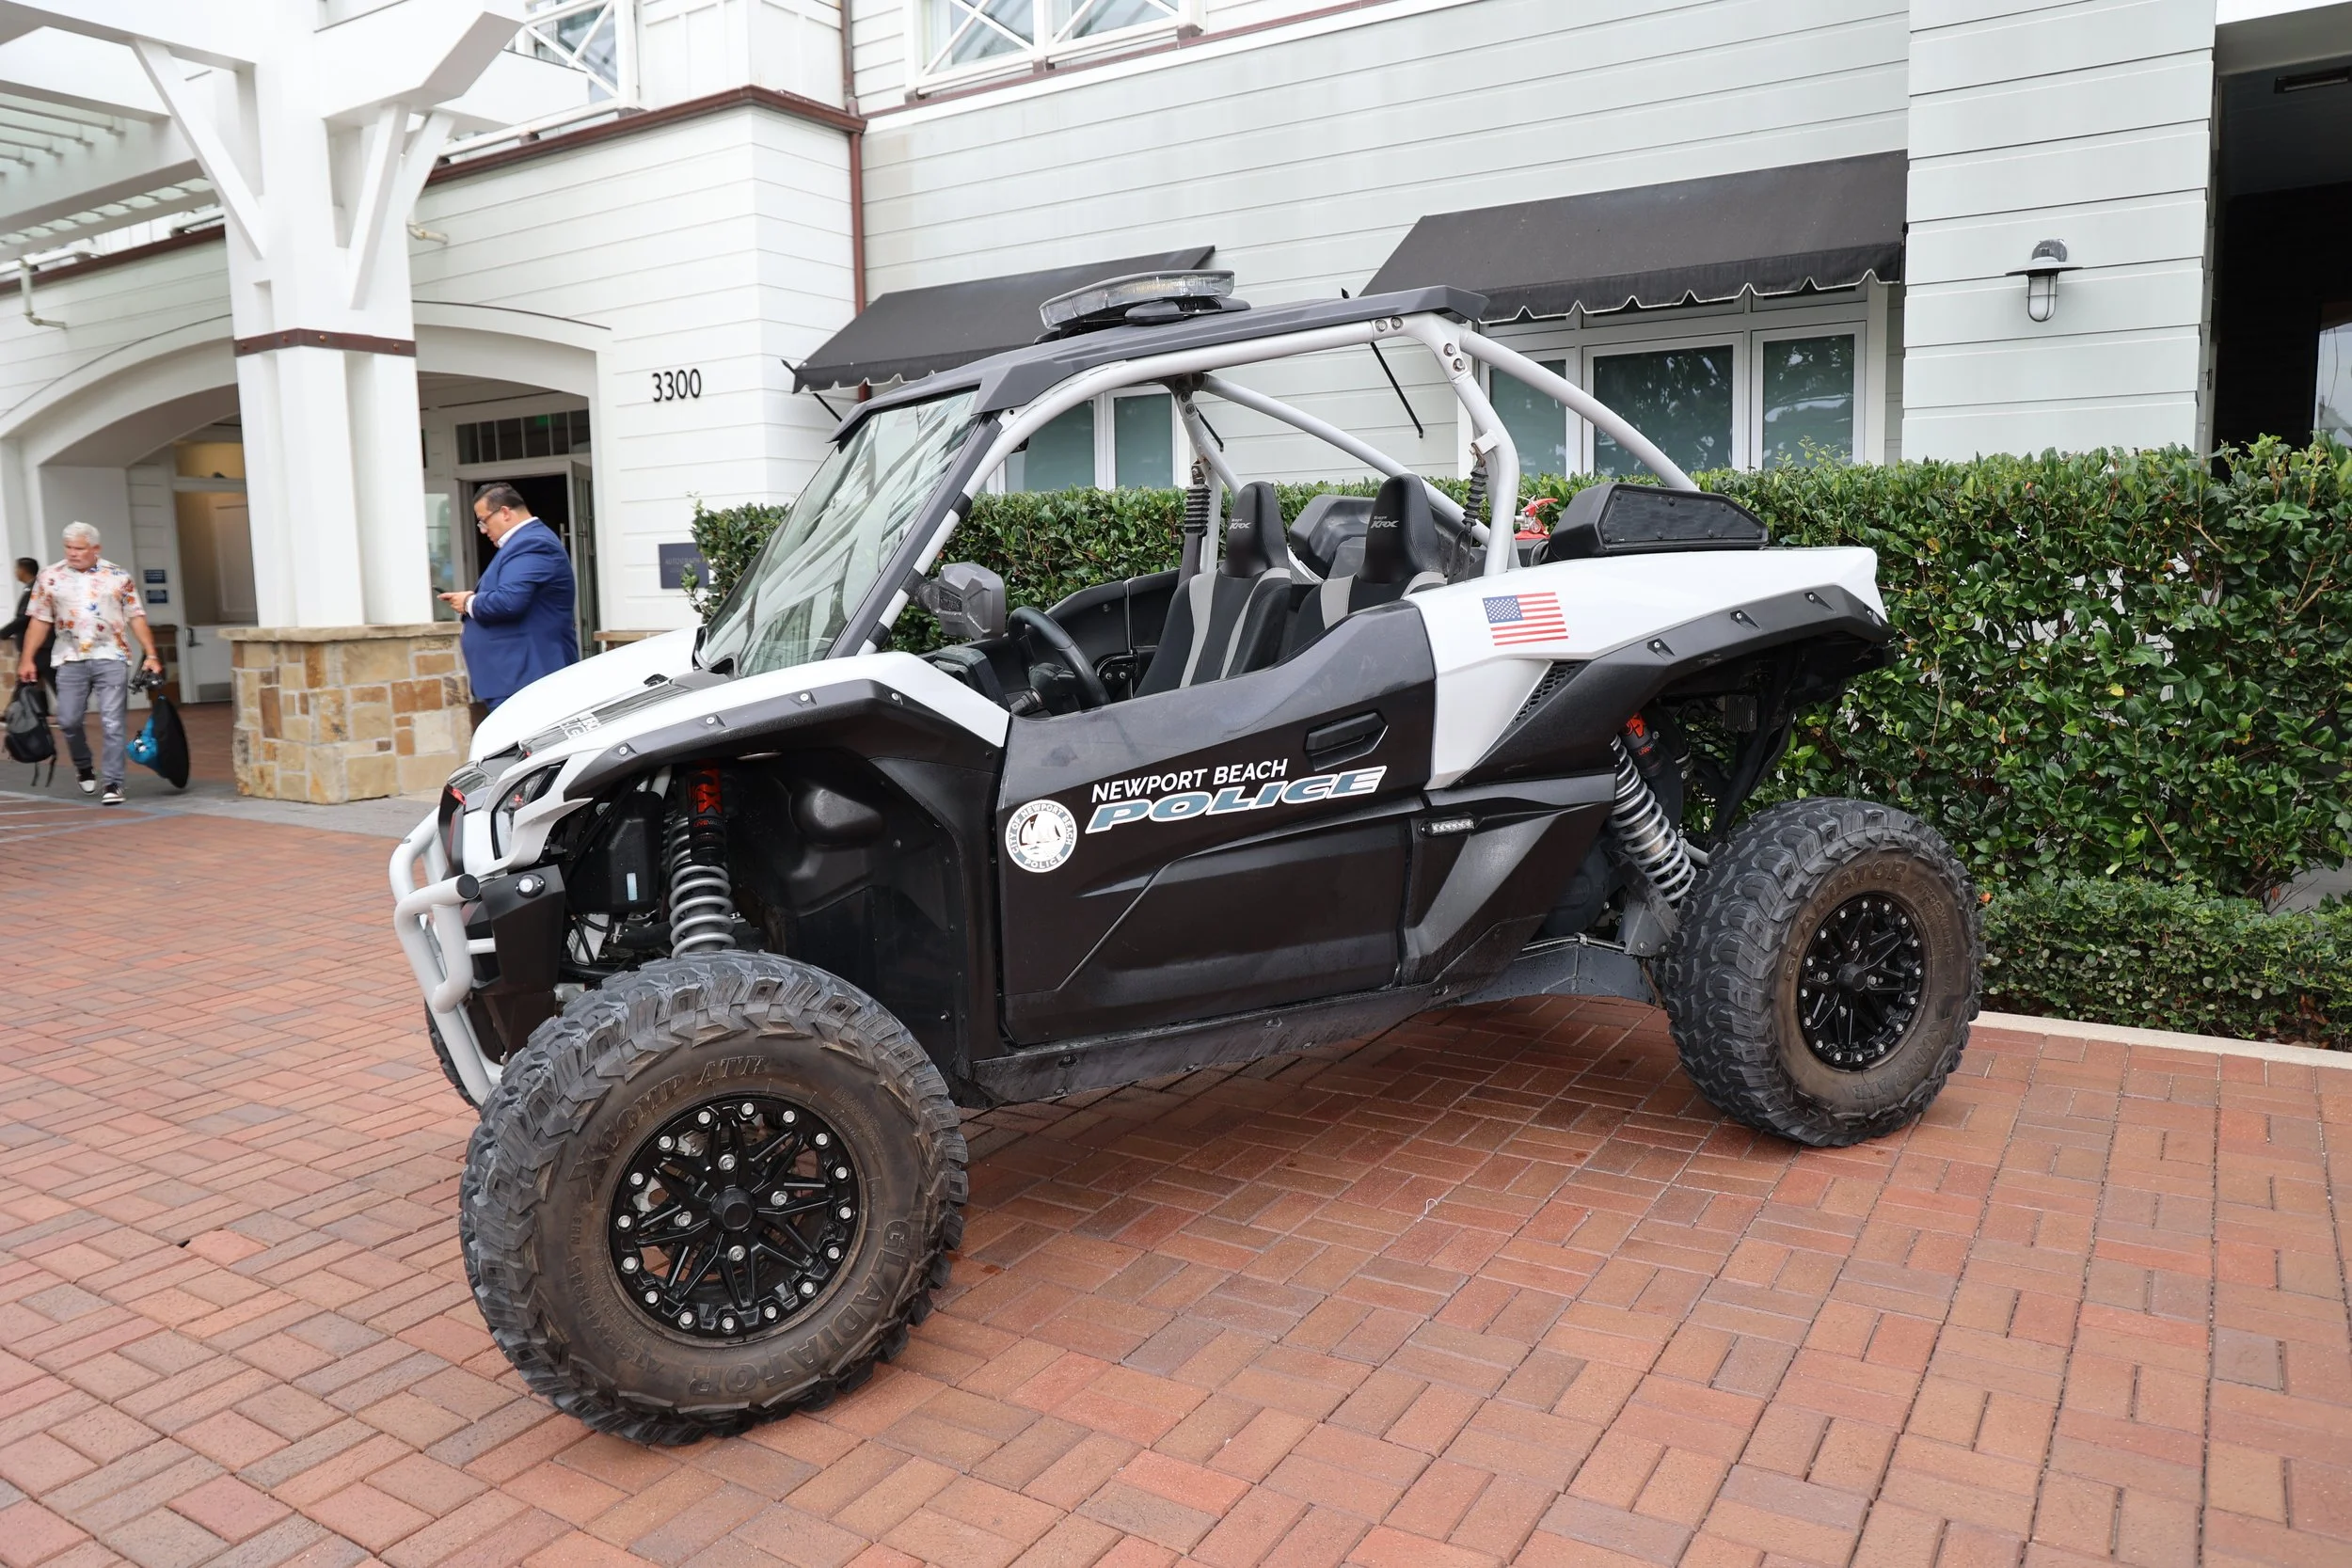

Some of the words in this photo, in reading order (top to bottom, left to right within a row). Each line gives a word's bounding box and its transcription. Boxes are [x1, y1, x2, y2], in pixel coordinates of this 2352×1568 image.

[652, 368, 702, 403] 3300
[1091, 768, 1207, 802] NEWPORT
[1213, 758, 1288, 786] BEACH
[1020, 803, 1063, 817] NEWPORT
[1085, 766, 1388, 834] POLICE
[1011, 818, 1021, 830] OF
[1062, 815, 1073, 845] BEACH
[1009, 832, 1020, 853] CITY
[1024, 853, 1063, 869] POLICE
[1785, 860, 1908, 982] GLADIATOR
[689, 1219, 913, 1397] GLADIATOR
